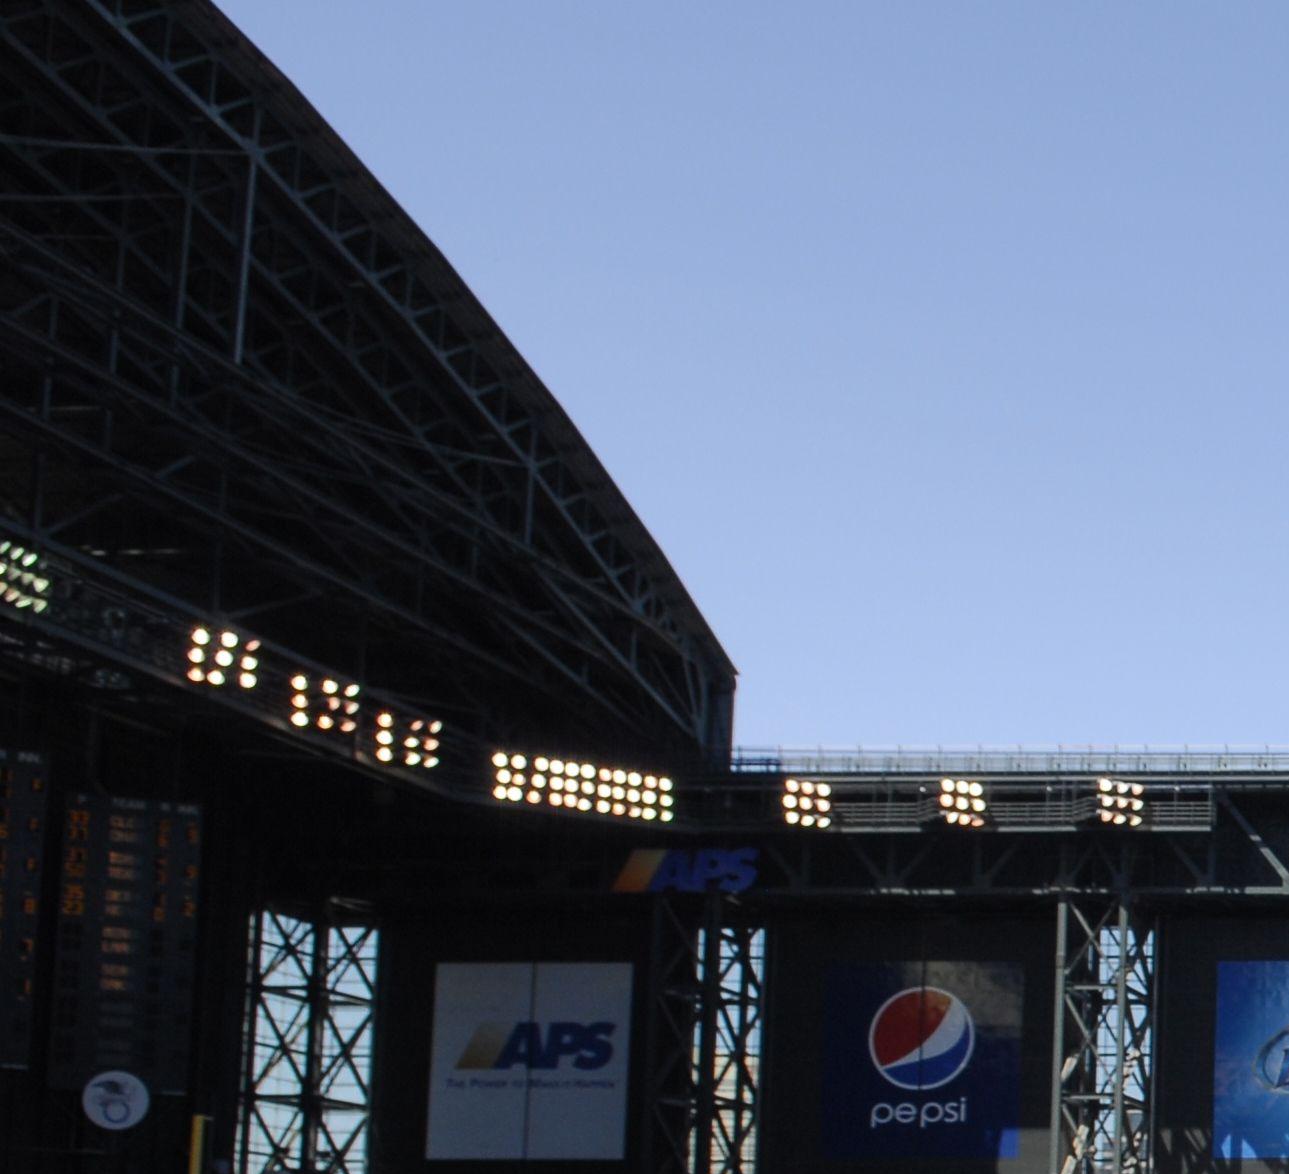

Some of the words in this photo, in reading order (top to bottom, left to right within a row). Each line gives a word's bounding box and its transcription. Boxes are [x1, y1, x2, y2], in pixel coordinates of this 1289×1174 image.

[648, 847, 761, 893] APS
[493, 1021, 617, 1070] APS
[869, 1097, 968, 1129] pepsi
